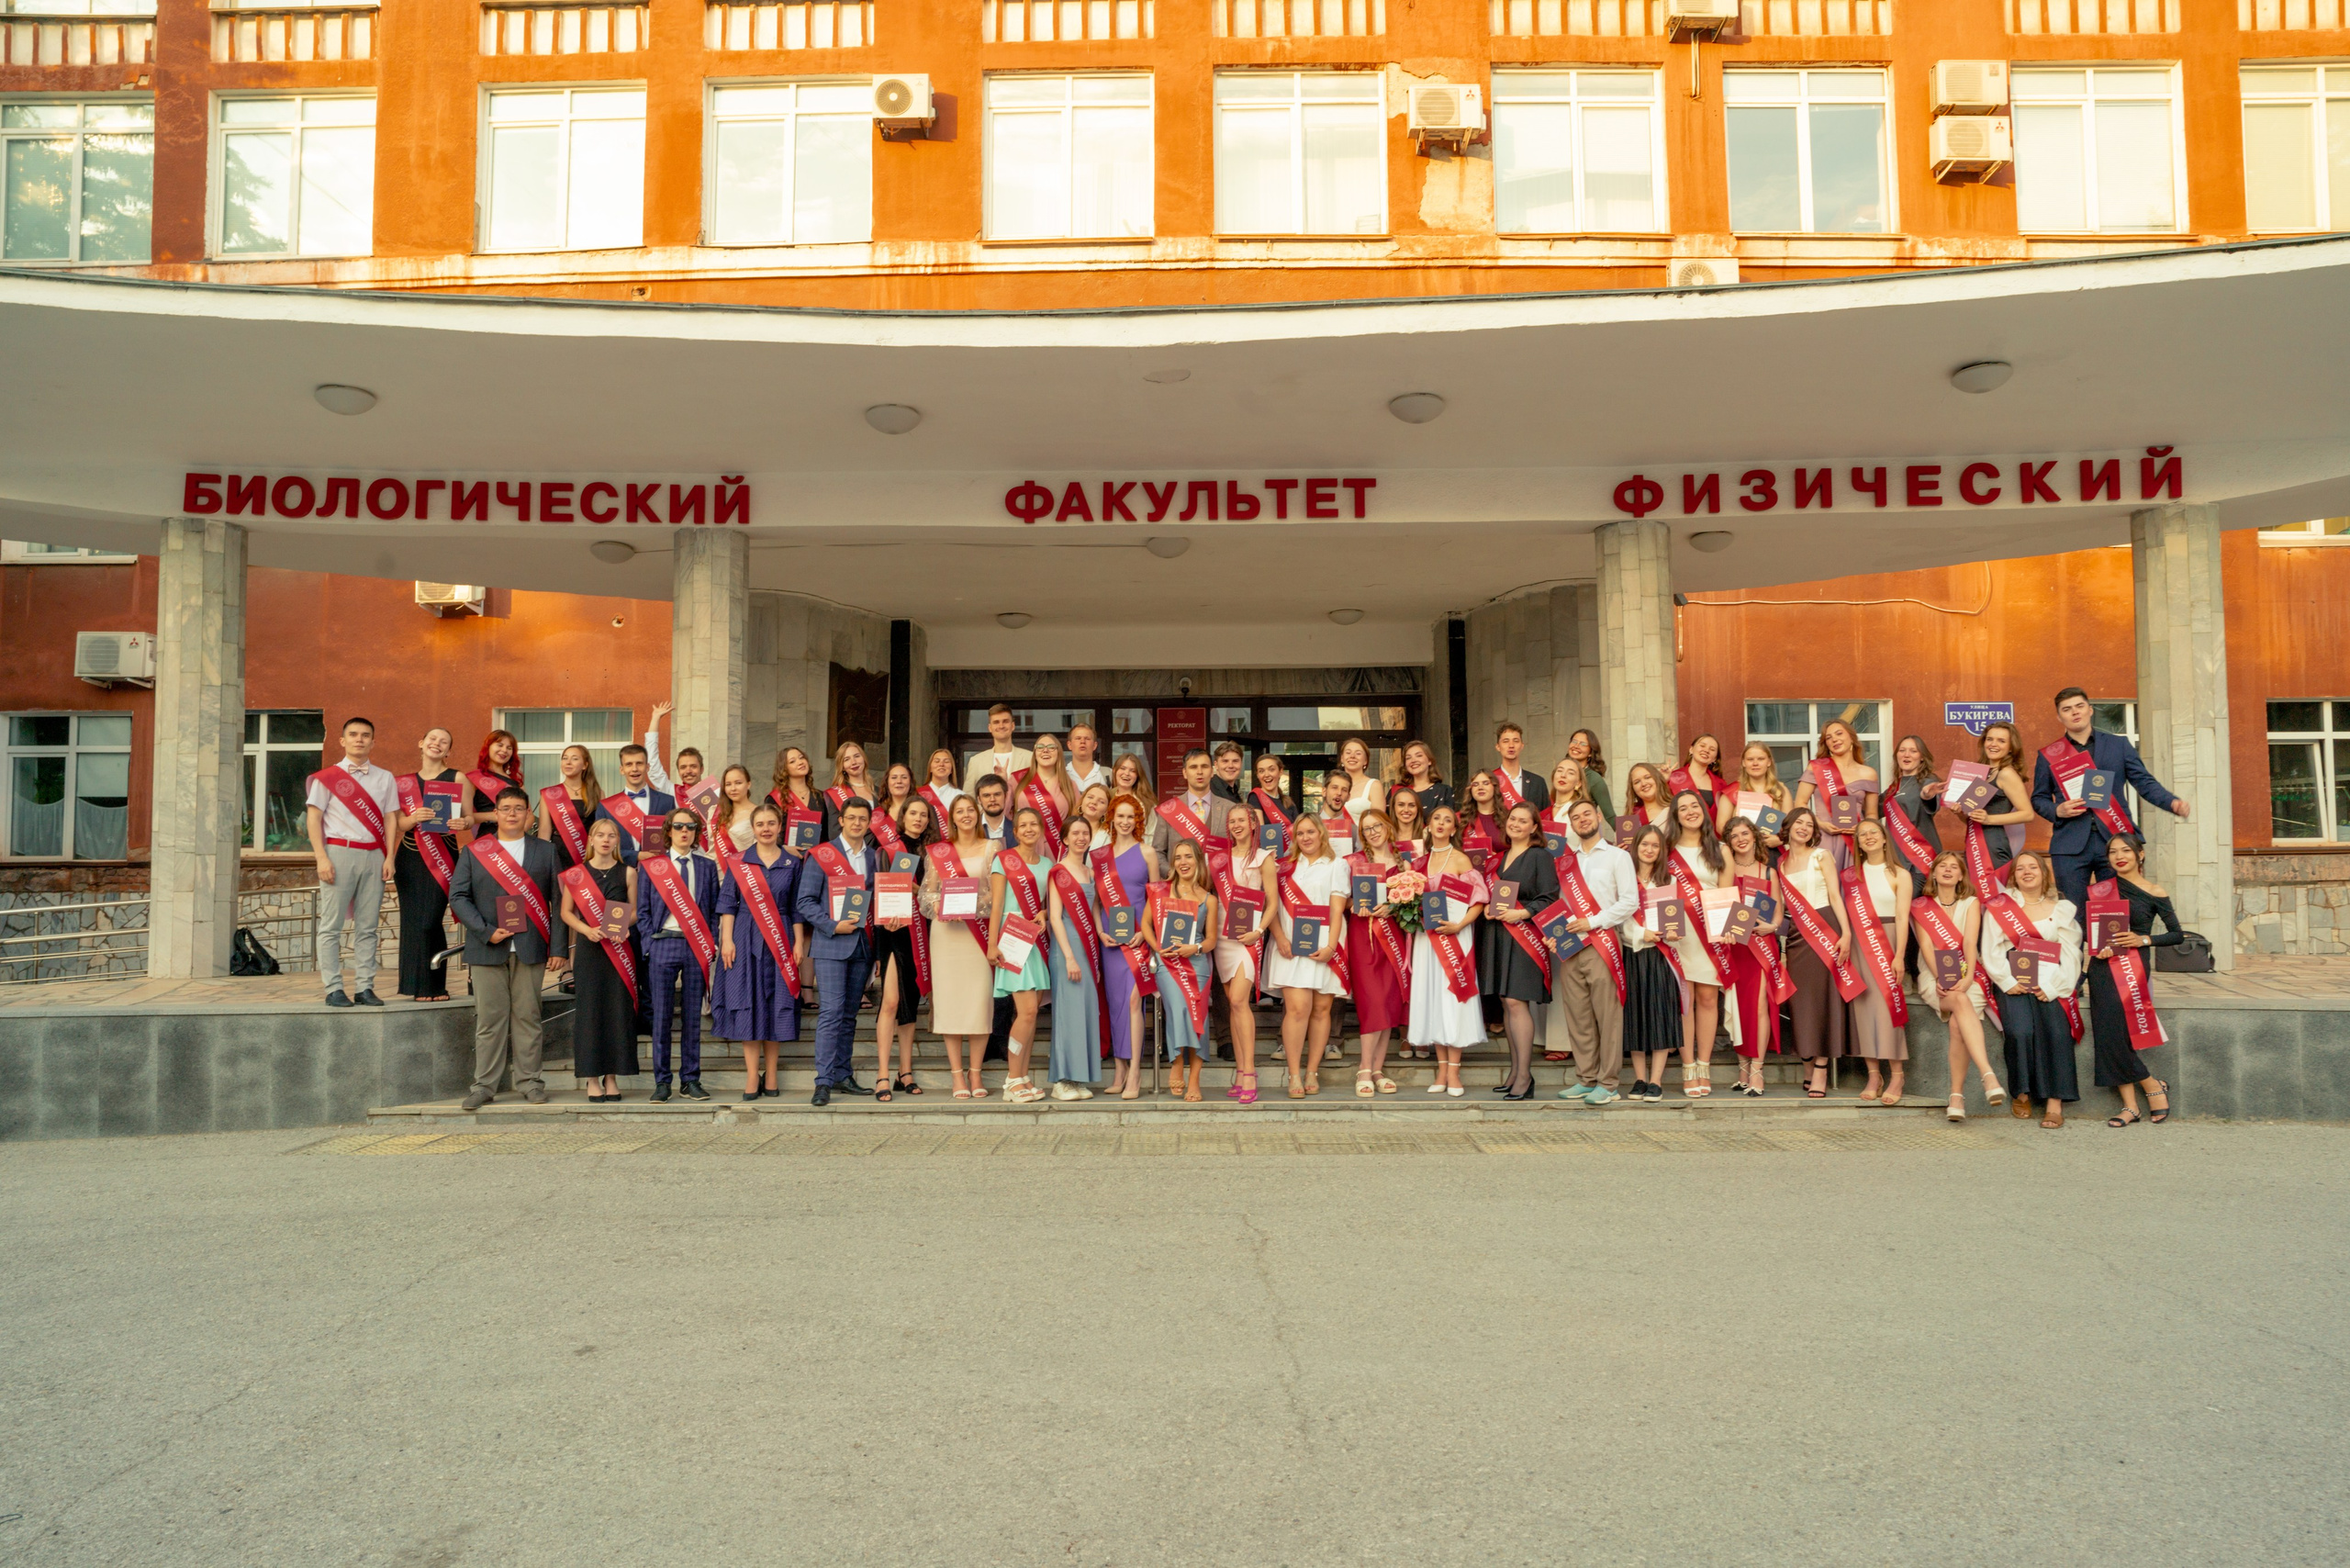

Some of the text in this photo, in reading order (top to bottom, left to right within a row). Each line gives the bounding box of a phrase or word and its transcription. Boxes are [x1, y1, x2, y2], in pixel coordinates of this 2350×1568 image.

[184, 445, 2183, 524] БИОЛОГИЧЕСКИЙ ФАКУЛЬТЕТ ФИЗИЧЕСКИЙ
[1949, 711, 2011, 720] БУКИРЕВА
[1822, 769, 1839, 797] ЛУЧШ
[354, 798, 384, 835] ЛУЧШИЙ
[555, 802, 581, 839] ЛУЧШИЙ
[1029, 784, 1061, 848] ЛУЧШИЙ ВЫПУС
[1175, 812, 1205, 844] ЛУЧШИ
[1886, 801, 1933, 868] ЛУЧШИЙ ВЫПУСК
[422, 834, 453, 884] ВЫПУСКНИ
[488, 852, 521, 887] ЛУЧШИЙ
[1668, 858, 1695, 898] ЛУЧШИЙ
[1017, 875, 1038, 918] ЛУЧШИ
[1101, 863, 1119, 904] ЛУЧШИЙ
[1218, 871, 1231, 901] ЛУЧШ
[1280, 876, 1300, 904] ЛУЧШИ
[1565, 872, 1591, 913] ЛУЧШИЙ
[1979, 878, 1991, 899] 2024
[664, 878, 712, 969] ЛУЧШИЙ ВЫПУСКН
[740, 864, 796, 981] ЛУЧШИЙ ВЫПУСКНИК 2024
[1069, 891, 1091, 934] ЛУЧШИЙ
[1924, 911, 1959, 951] ЛУЧШИЙ
[2002, 910, 2030, 938] ЛУЧШ
[580, 888, 603, 924] ЛУЧШИ
[610, 940, 636, 985] ЫПУСКНИК
[1516, 920, 1548, 959] ПУСКНИК
[1851, 886, 1902, 1014] ЛУЧШИЙ ВЫПУСКНИК 2024
[1138, 962, 1150, 981] 2024
[1170, 955, 1194, 998] ПУСКНИК
[1338, 962, 1349, 980] 2024
[1438, 932, 1468, 988] СКНИК 2024
[1718, 953, 1731, 975] 2024
[1754, 935, 1785, 990] СКНИК 2024
[1837, 965, 1853, 987] 2024
[2136, 1012, 2149, 1035] 2024
